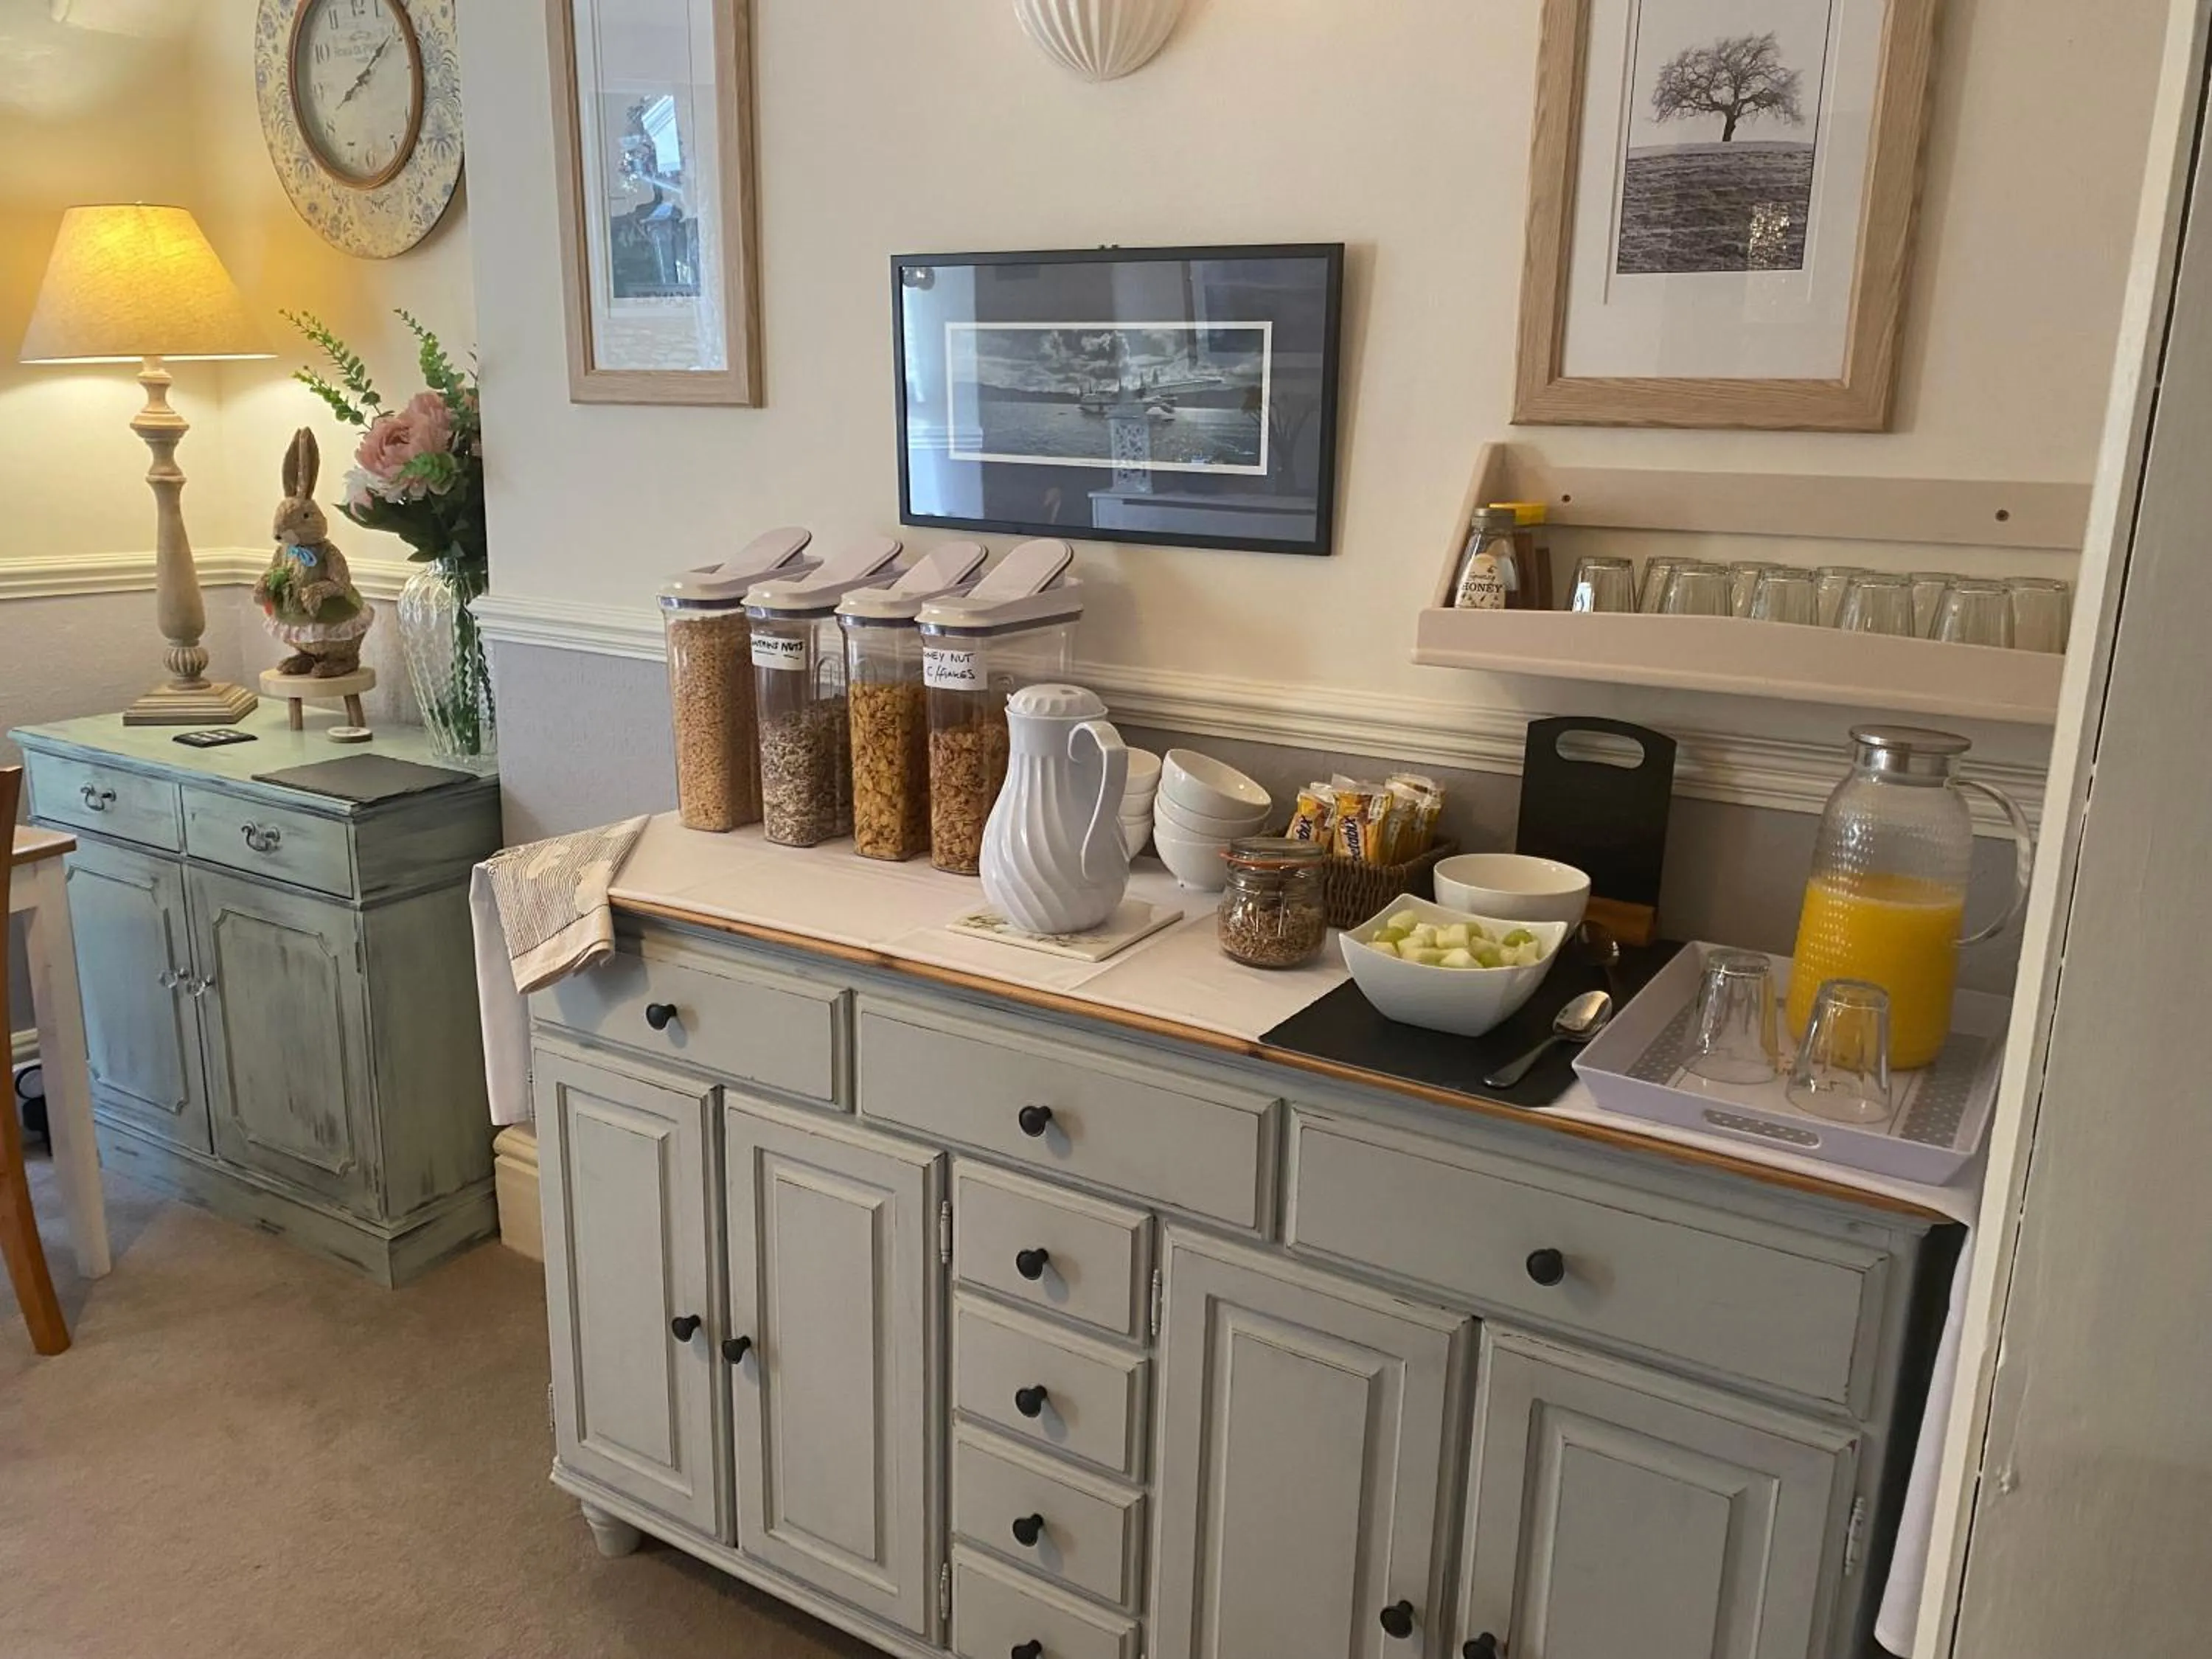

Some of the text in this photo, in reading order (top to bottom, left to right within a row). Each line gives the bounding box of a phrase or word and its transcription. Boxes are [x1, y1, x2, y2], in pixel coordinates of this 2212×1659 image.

[316, 43, 330, 65] 10
[1462, 581, 1503, 594] HONEY
[782, 641, 803, 652] NUTS
[950, 653, 976, 663] NUT
